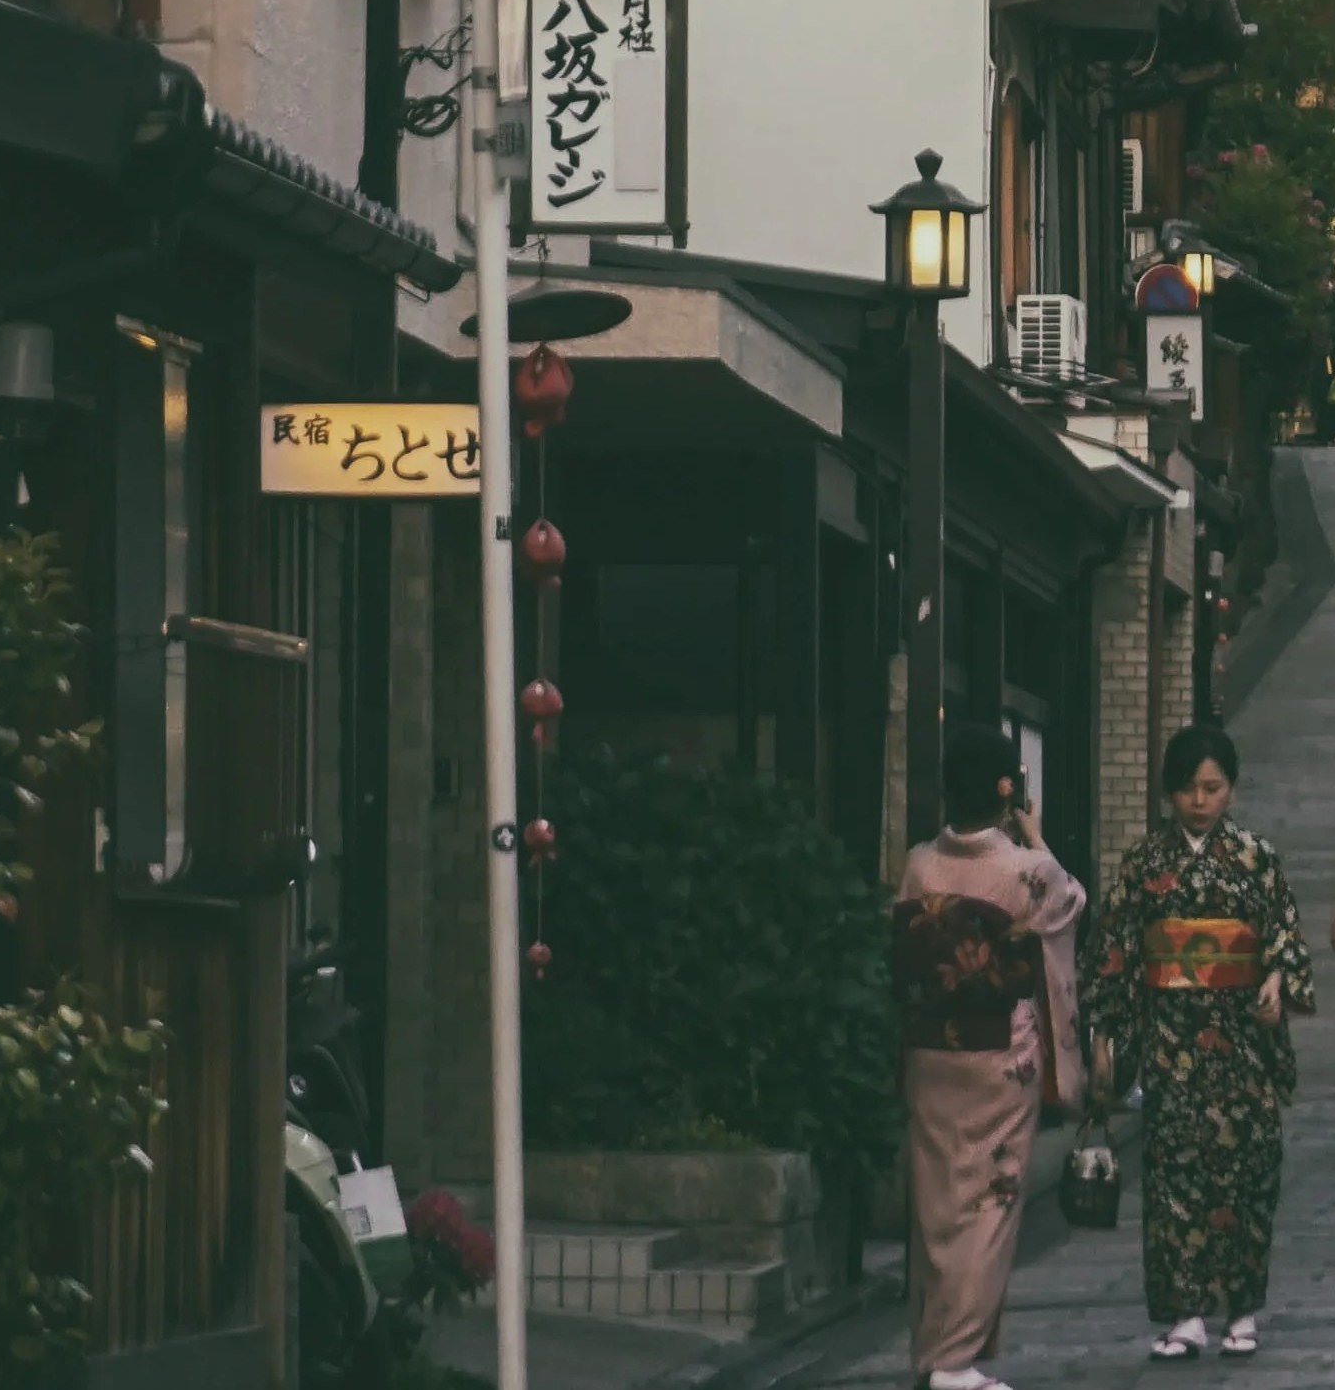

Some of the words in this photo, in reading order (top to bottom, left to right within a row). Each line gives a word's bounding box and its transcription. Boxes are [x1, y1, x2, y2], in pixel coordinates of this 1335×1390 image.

[272, 413, 332, 445] 民宿
[340, 423, 481, 482] ちとせ
